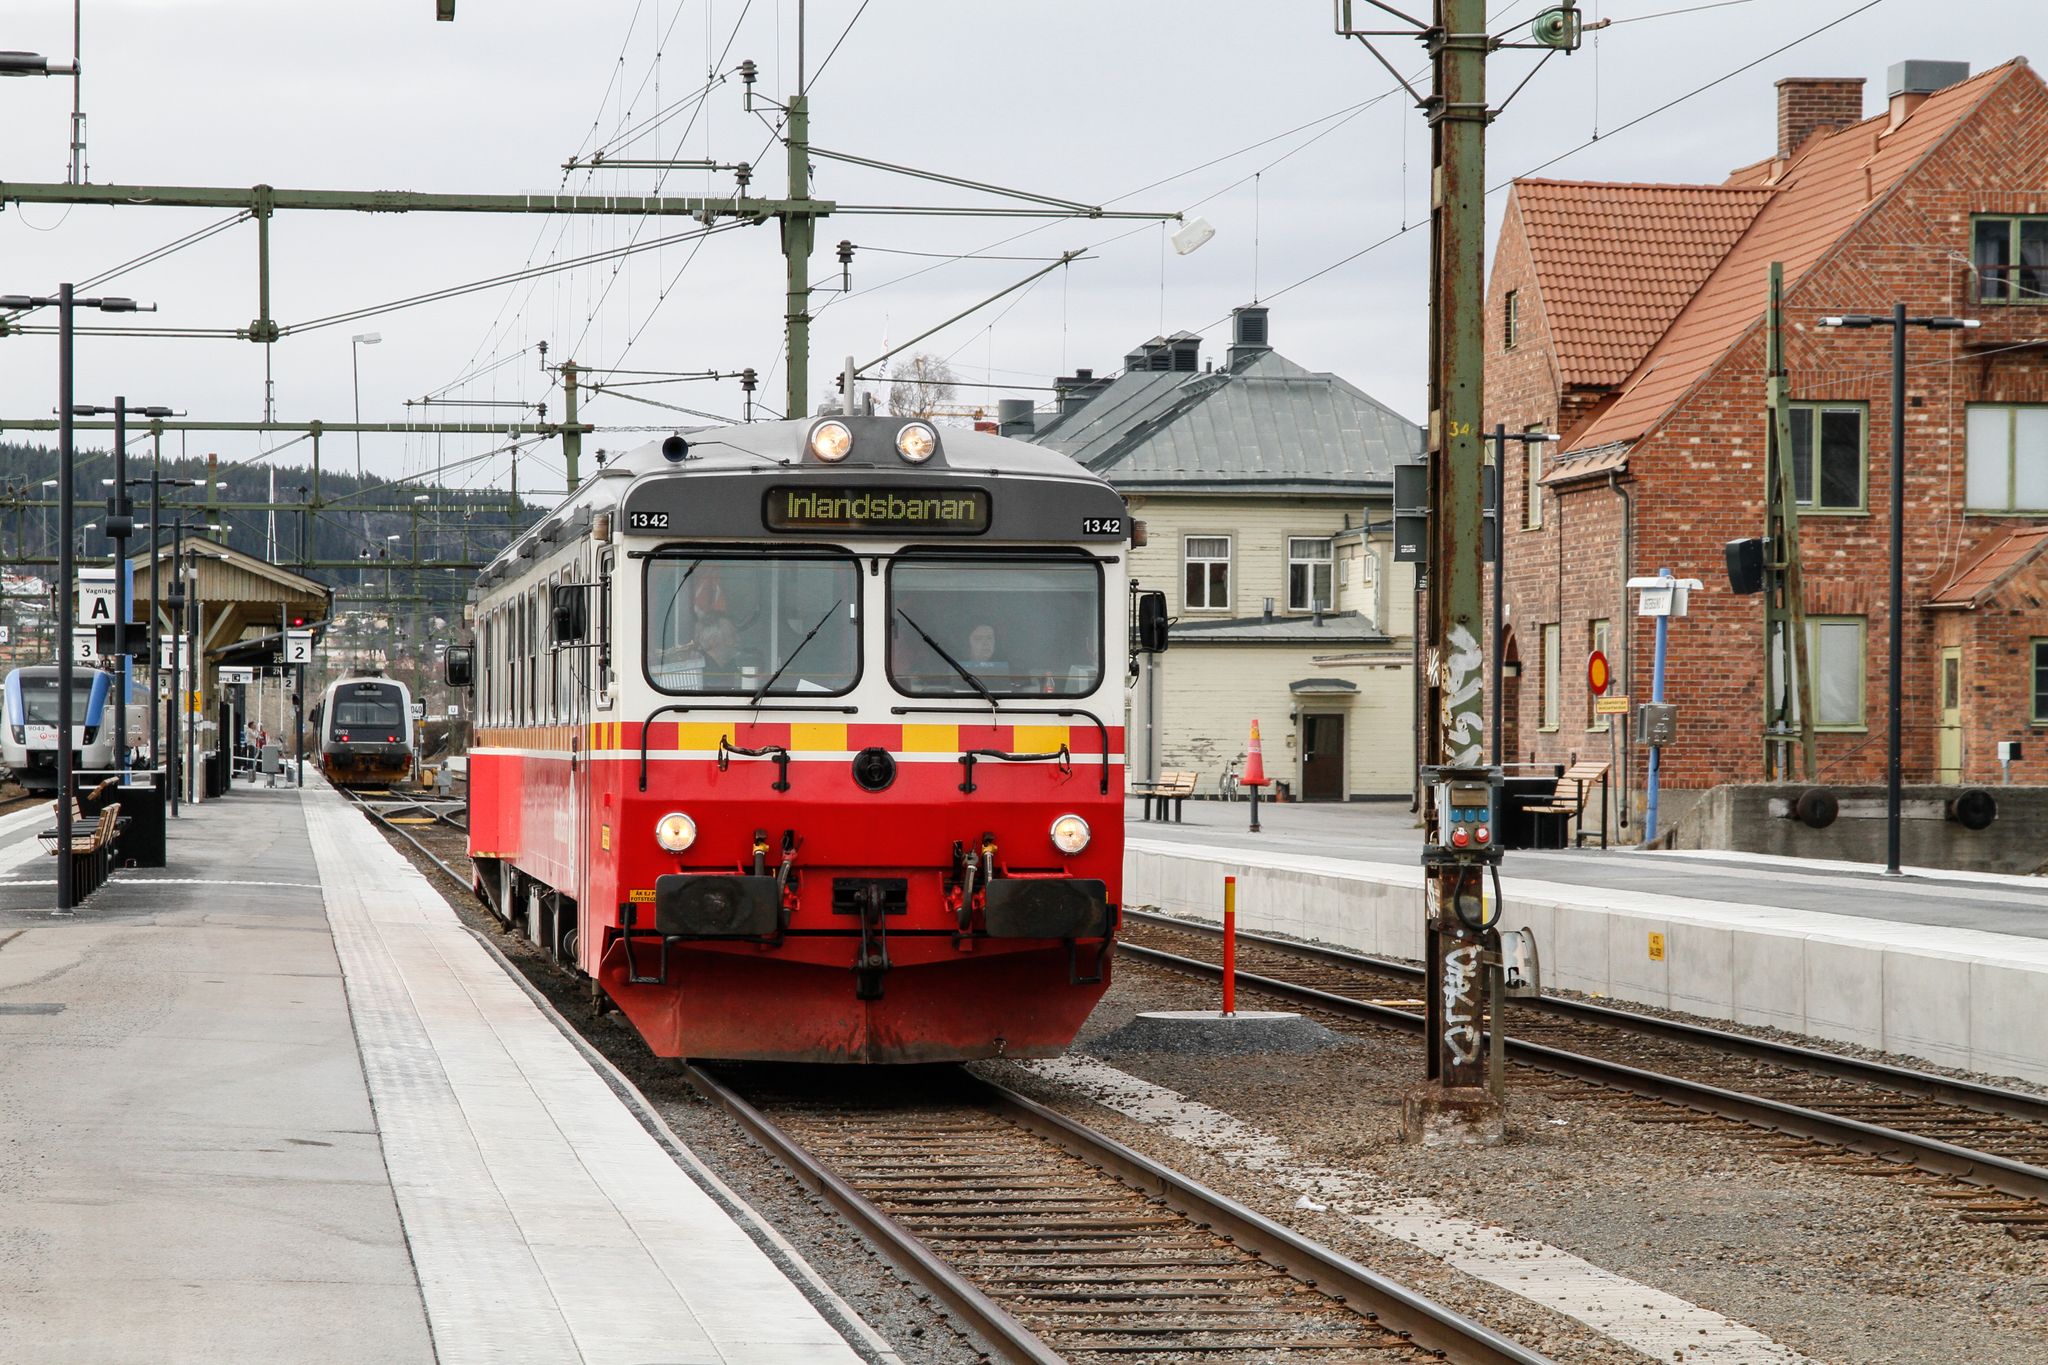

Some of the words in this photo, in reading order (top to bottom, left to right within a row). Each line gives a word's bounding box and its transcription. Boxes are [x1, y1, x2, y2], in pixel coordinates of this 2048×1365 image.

[787, 492, 975, 520] Inlandsbanan
[630, 513, 668, 527] 1342
[1083, 519, 1120, 533] 1342
[91, 597, 110, 619] A
[81, 644, 91, 658] 3
[294, 646, 304, 660] 2
[160, 679, 167, 687] 3
[285, 679, 292, 688] 2
